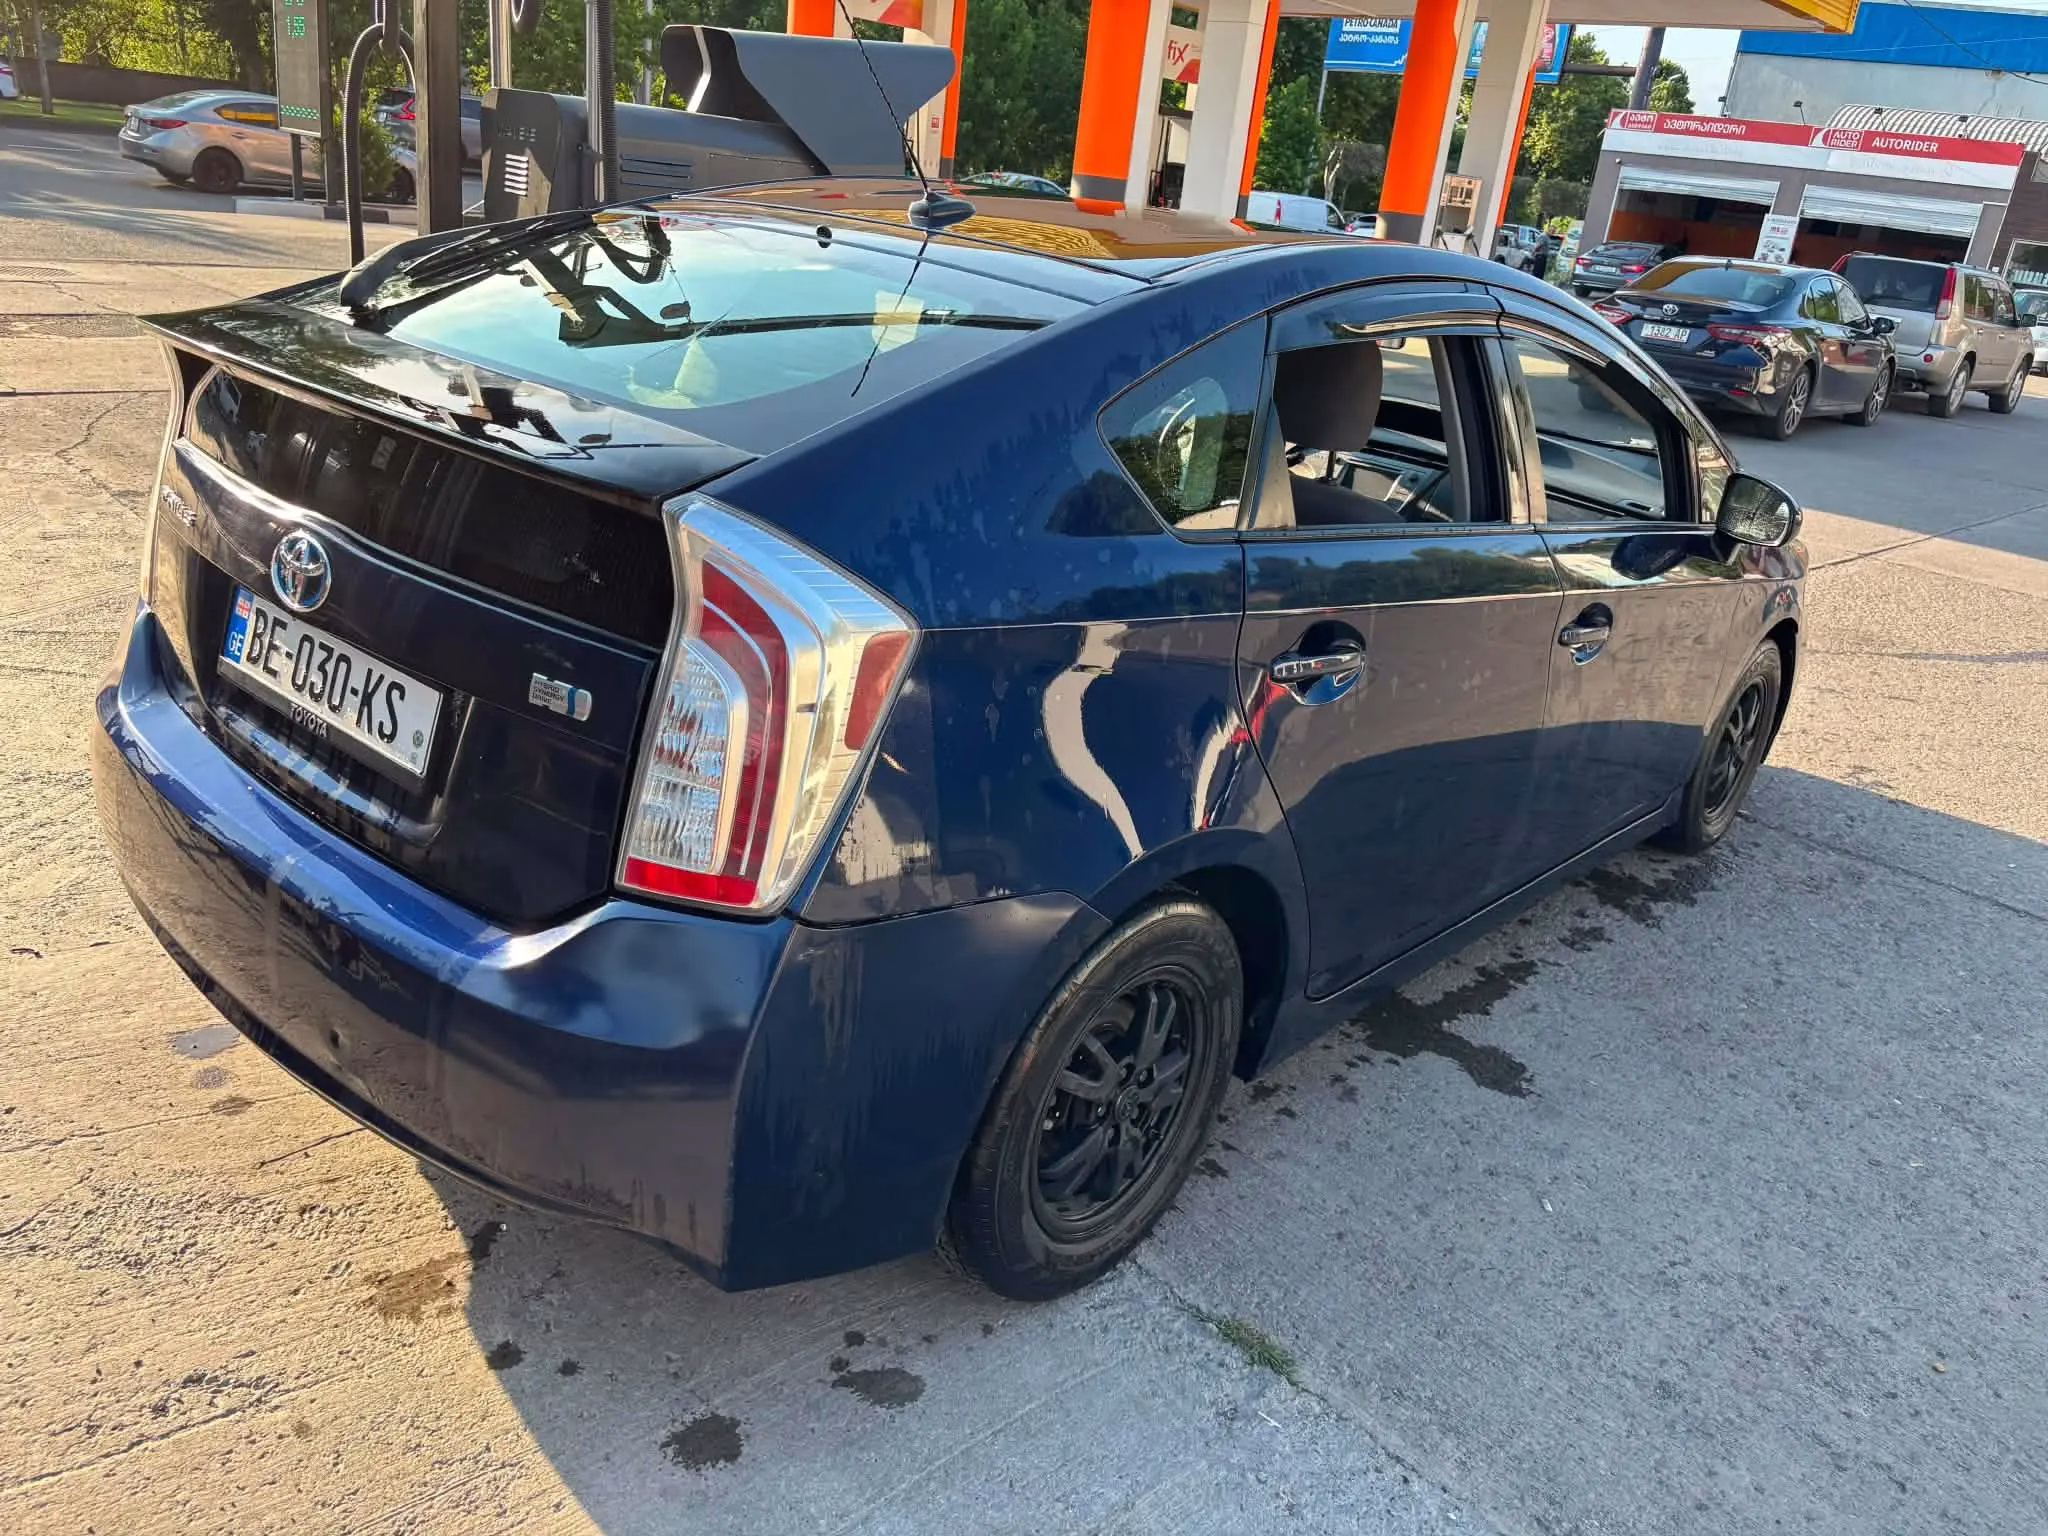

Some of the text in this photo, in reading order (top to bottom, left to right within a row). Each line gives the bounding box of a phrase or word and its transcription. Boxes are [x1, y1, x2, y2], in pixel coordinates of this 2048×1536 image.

[1167, 39, 1189, 66] fix
[1830, 138, 1858, 148] RIDER
[1831, 130, 1860, 140] AUTO
[1871, 136, 1939, 153] AUTORIDER
[227, 631, 245, 656] GE
[246, 606, 406, 744] BE-030-KS
[289, 703, 328, 738] TOYOTA
